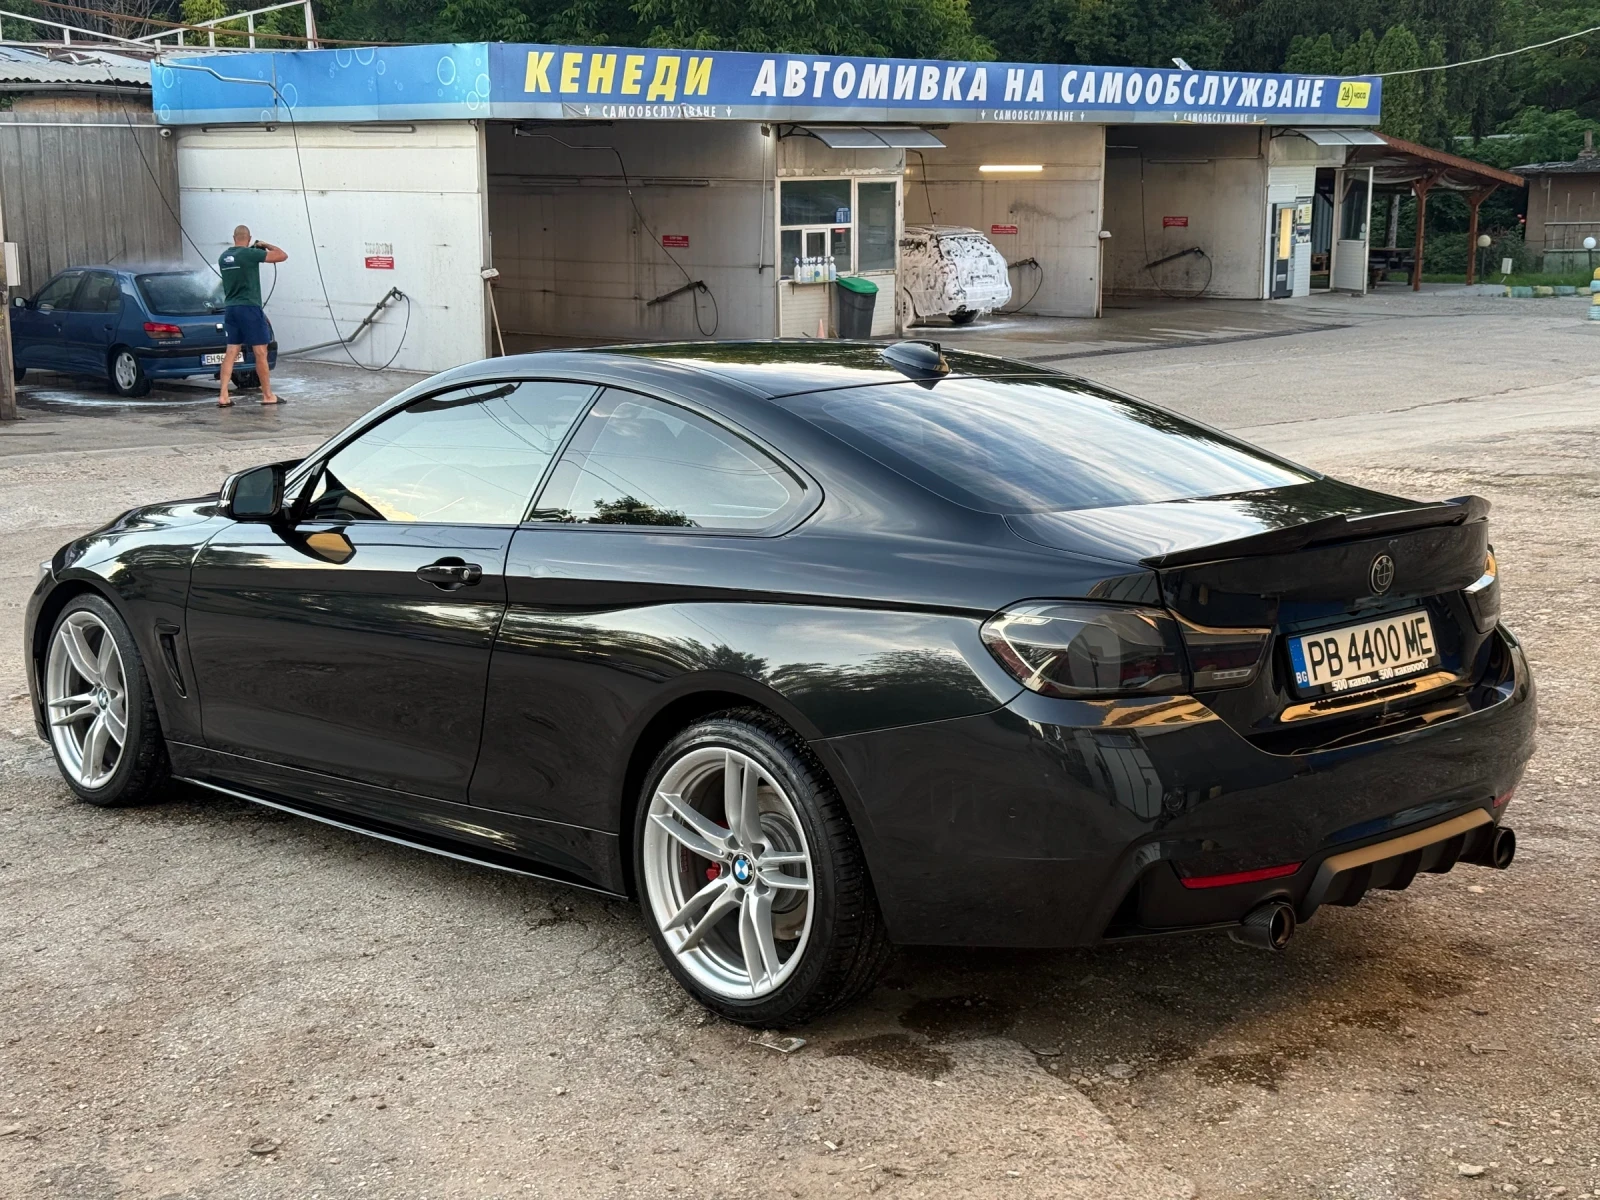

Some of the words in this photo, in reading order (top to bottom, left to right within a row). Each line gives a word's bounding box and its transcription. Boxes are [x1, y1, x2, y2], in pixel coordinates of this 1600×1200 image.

[524, 51, 714, 102] КЕНЕДИ
[750, 59, 987, 101] АВТОМИВКА
[1004, 68, 1044, 102] НА
[1061, 70, 1325, 108] САМООБСЛУЖВАНЕ
[602, 105, 716, 118] САМООБСЛУЖВАНЕ
[994, 110, 1074, 121] САМООБСЛУЖВАНЕ
[1183, 112, 1248, 123] САМООБСЛУЖВАНЕ
[1307, 637, 1344, 681] PB
[1347, 624, 1400, 671] 4400
[1402, 616, 1433, 659] ME
[1295, 671, 1308, 683] BG
[1332, 679, 1348, 692] 500
[1378, 667, 1394, 680] 500
